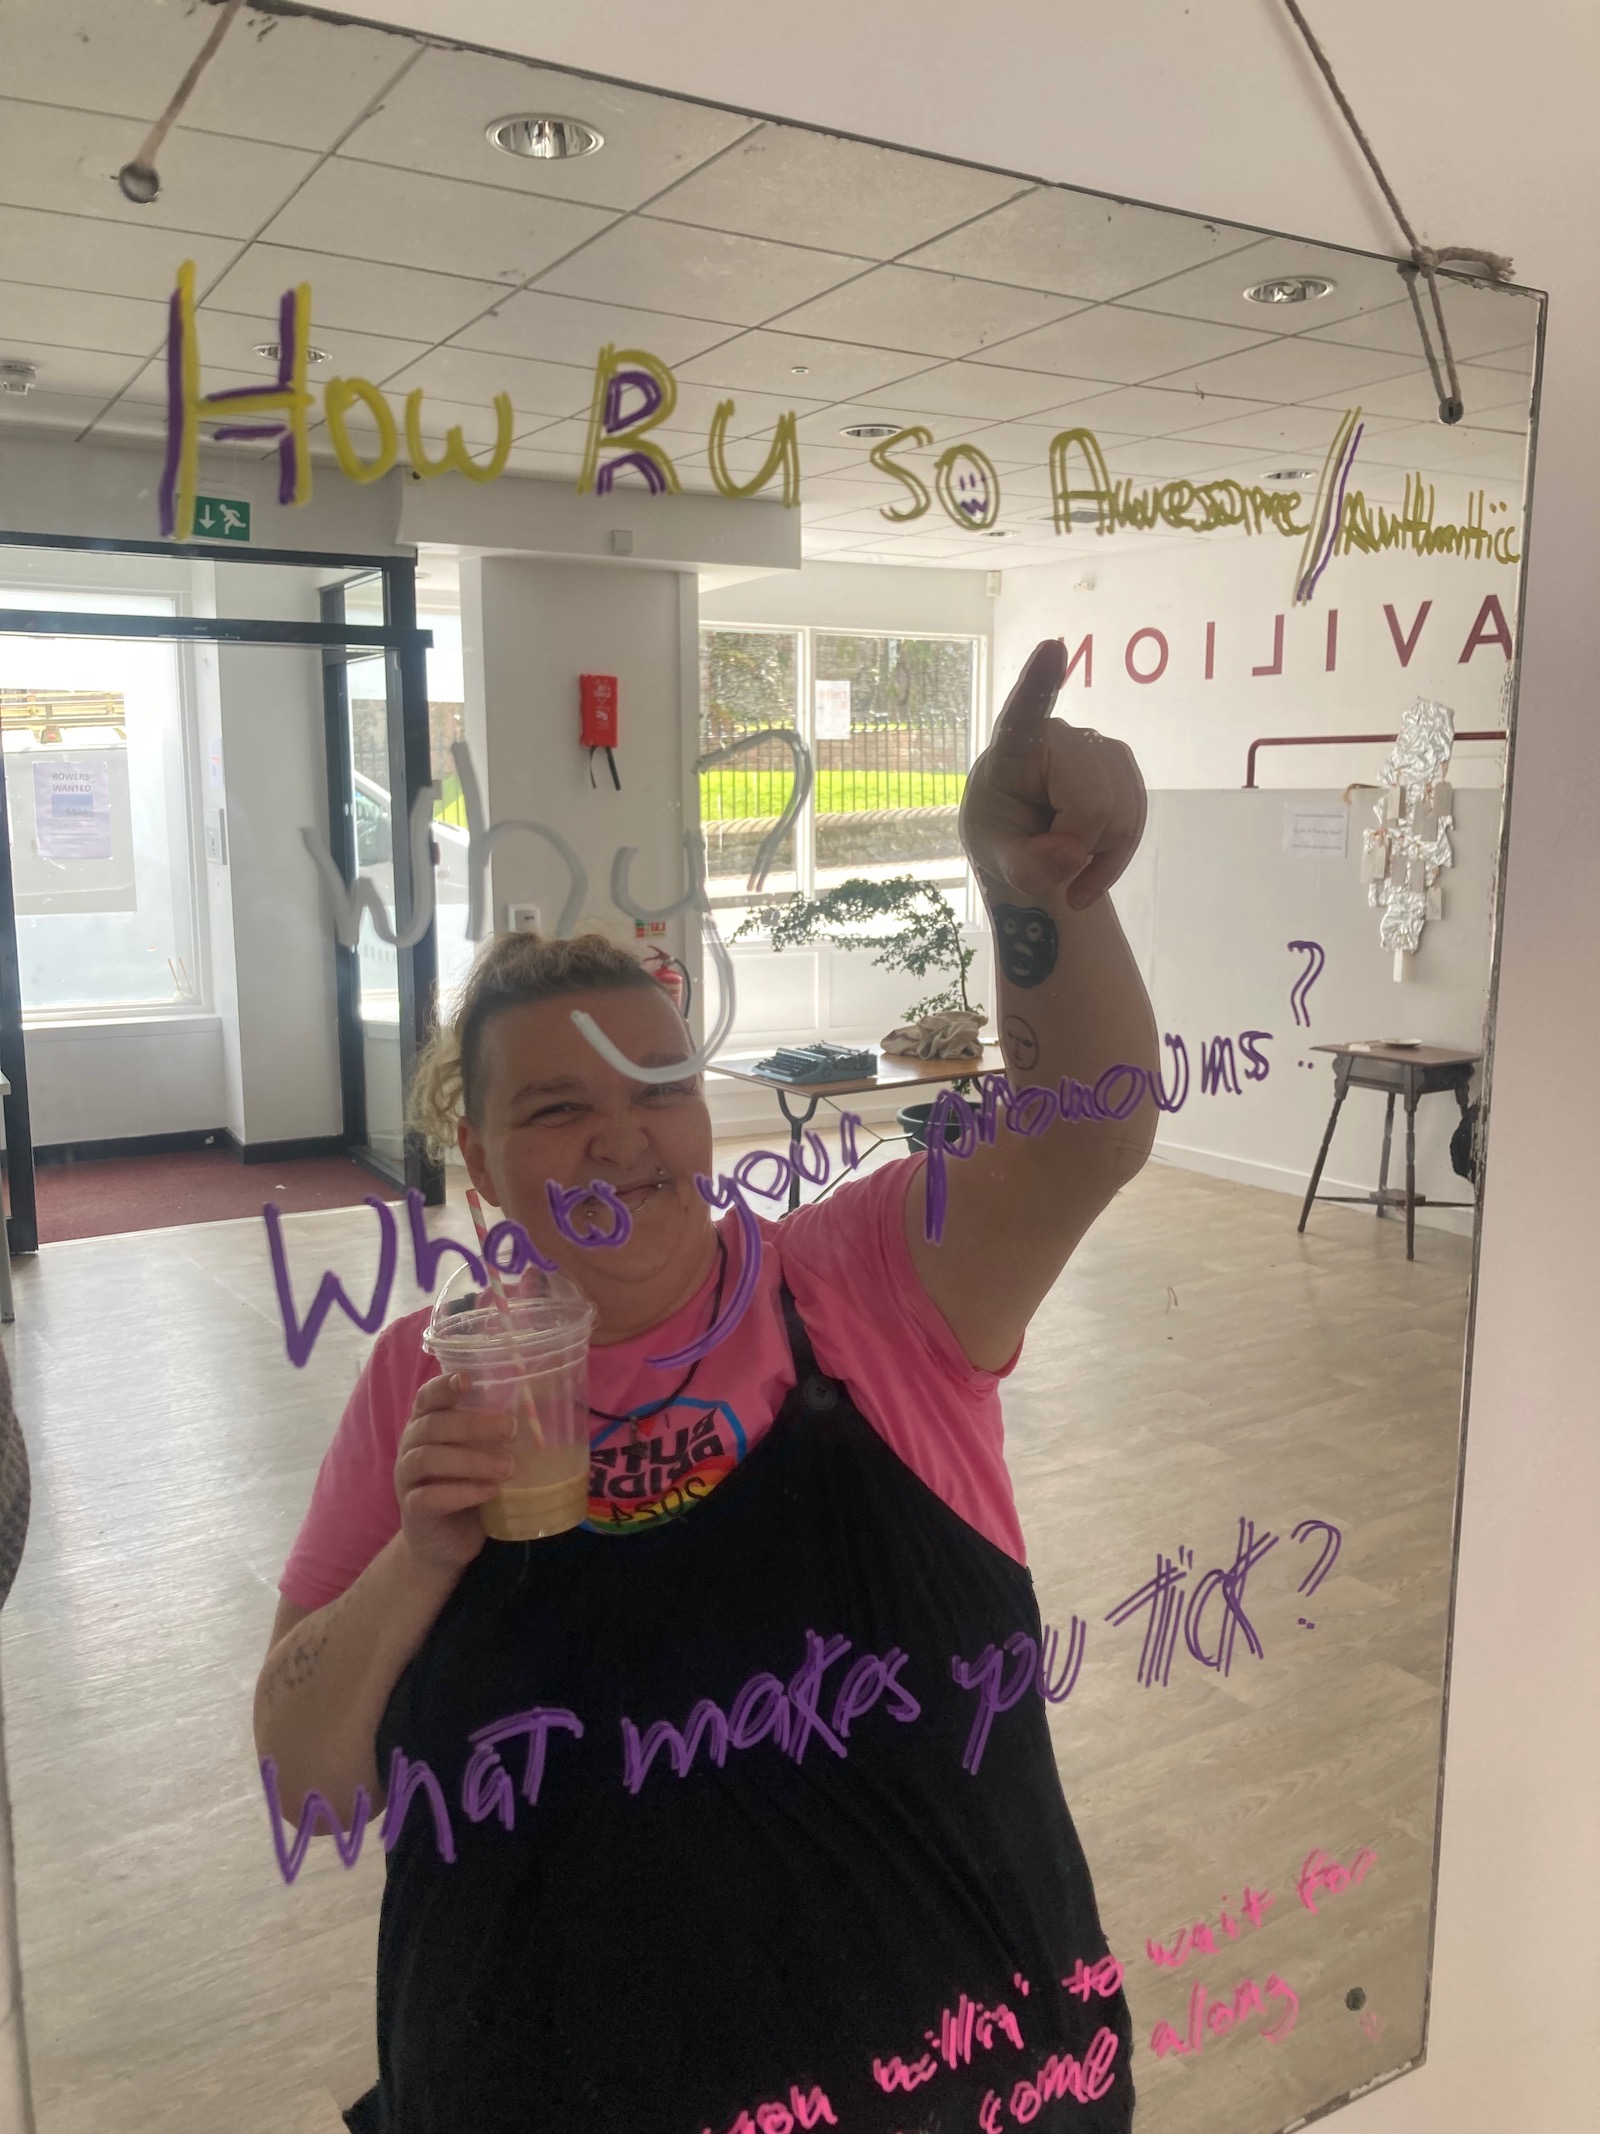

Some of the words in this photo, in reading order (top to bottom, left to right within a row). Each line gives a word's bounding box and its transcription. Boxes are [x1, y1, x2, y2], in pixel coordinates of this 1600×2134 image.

[52, 772, 90, 782] ROWERS
[53, 784, 91, 793] WANTED
[1061, 1954, 1124, 2003] to
[1146, 1886, 1277, 1968] wait
[1297, 1848, 1378, 1915] for
[979, 2027, 1119, 2134] come
[1150, 1972, 1299, 2059] along
